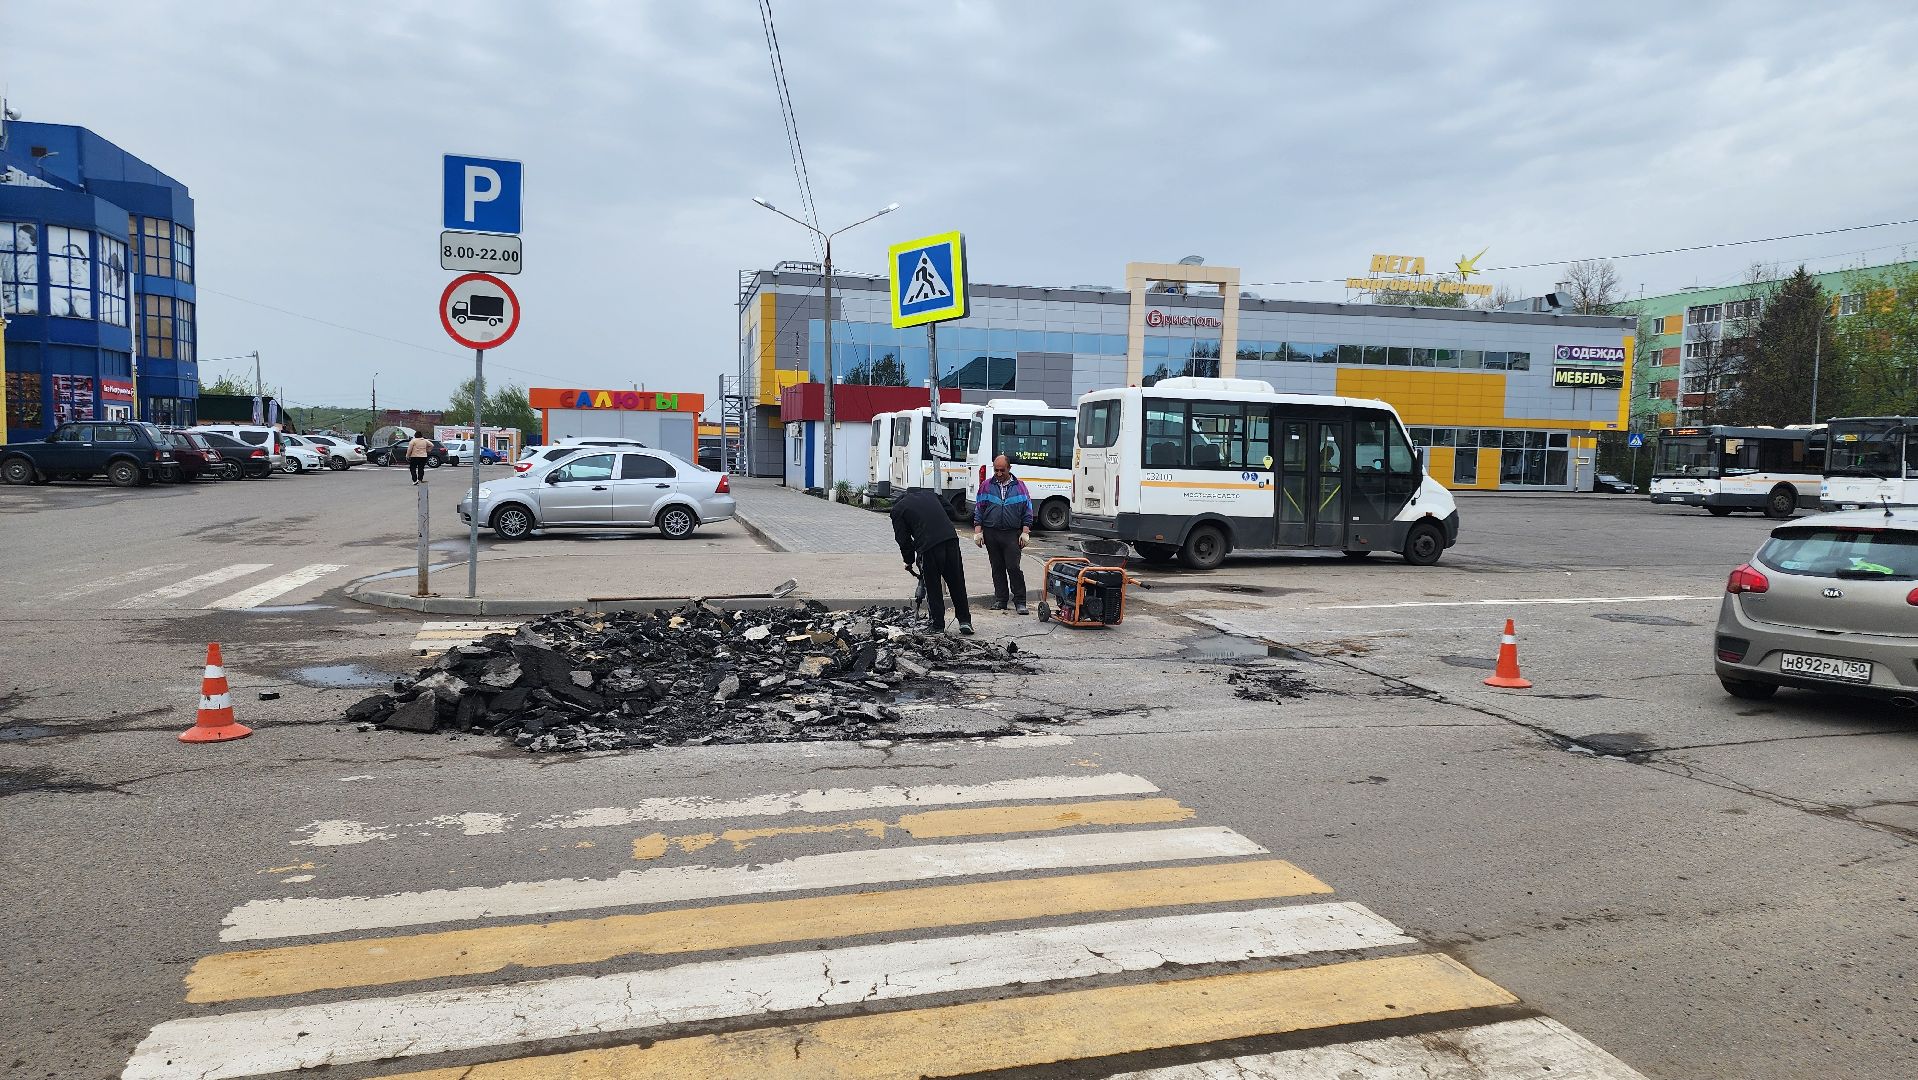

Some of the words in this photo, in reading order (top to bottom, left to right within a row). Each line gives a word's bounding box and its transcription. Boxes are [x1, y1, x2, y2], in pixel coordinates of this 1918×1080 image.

[464, 164, 502, 222] P
[443, 245, 519, 262] 8.00-22.00
[1370, 254, 1425, 275] ВЕГА
[1571, 347, 1624, 360] ОДЕЖДА
[1555, 370, 1606, 385] МЕБЕЛЬ
[560, 390, 679, 410] САЛЮТЫ
[1823, 587, 1841, 597] KIA
